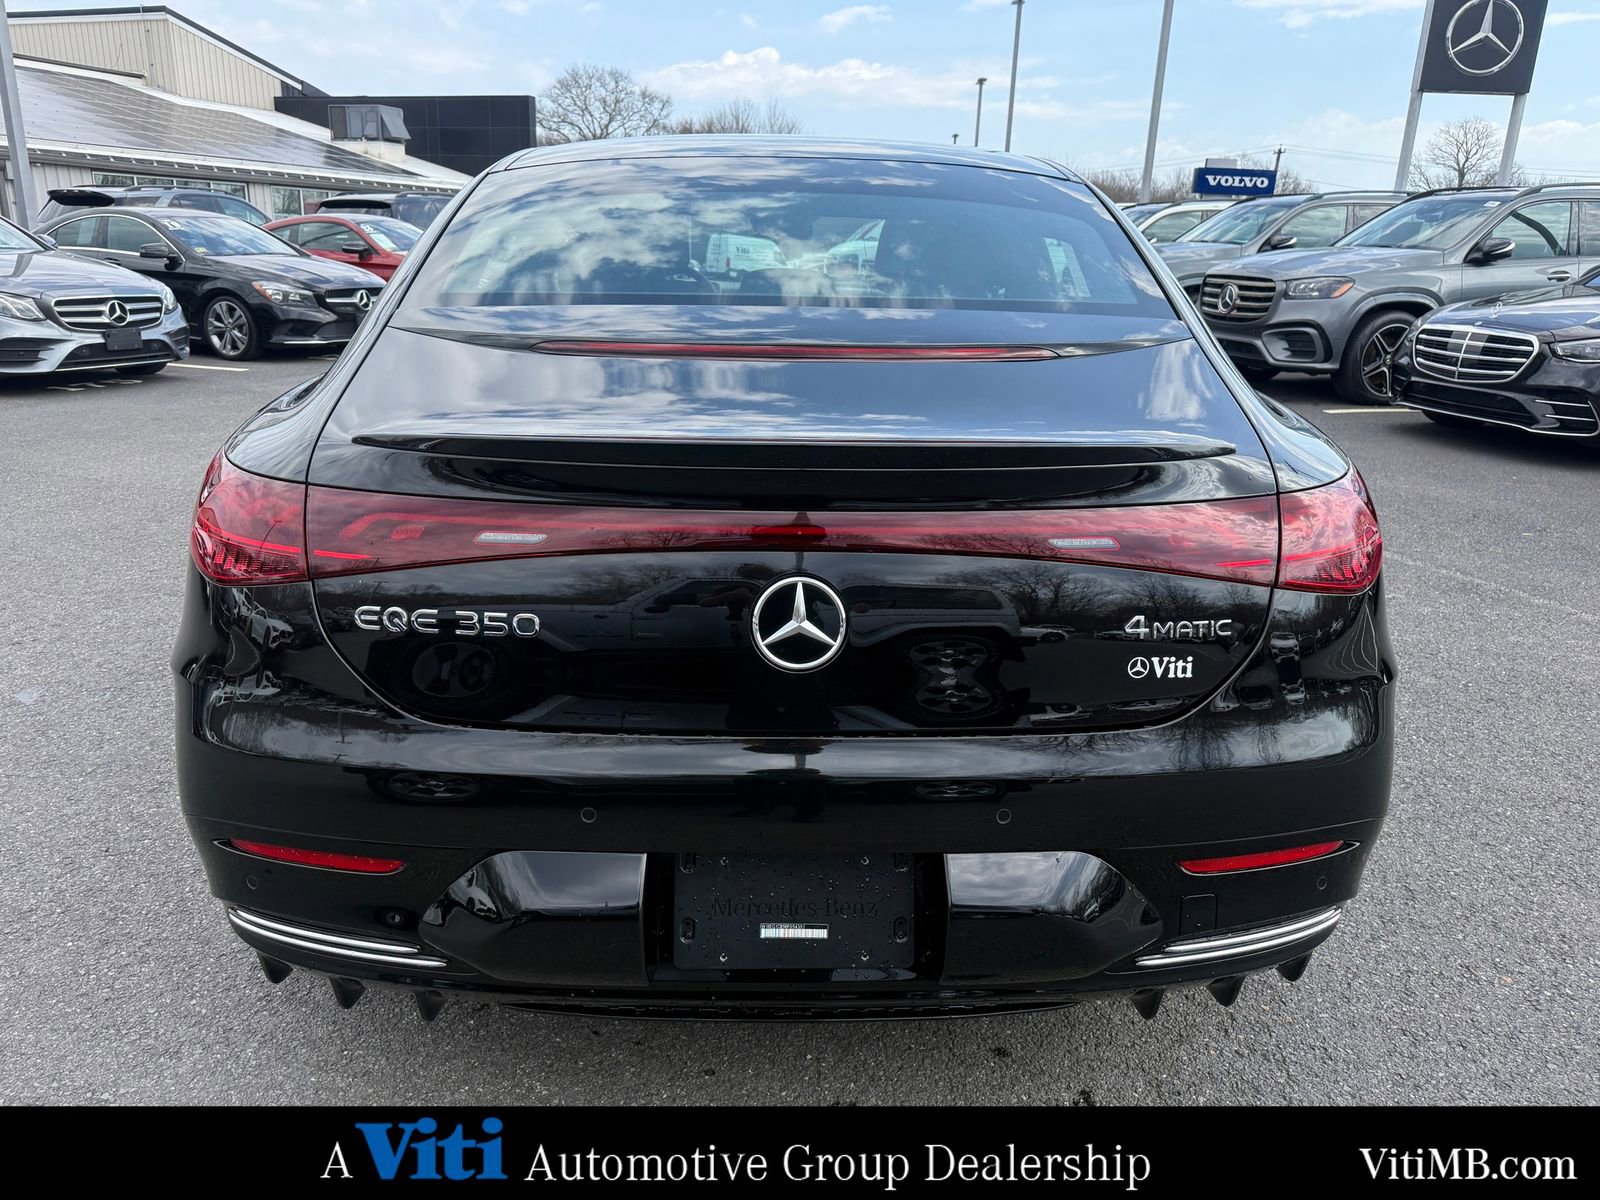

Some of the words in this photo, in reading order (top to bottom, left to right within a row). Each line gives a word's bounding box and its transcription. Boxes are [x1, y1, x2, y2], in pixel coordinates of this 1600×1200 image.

[1205, 174, 1270, 188] VOLVO
[354, 605, 439, 634] EQE
[455, 610, 540, 638] 350
[1124, 615, 1232, 639] 4MATIC
[1151, 656, 1193, 679] Viti
[711, 897, 879, 917] Mercedes-Benz
